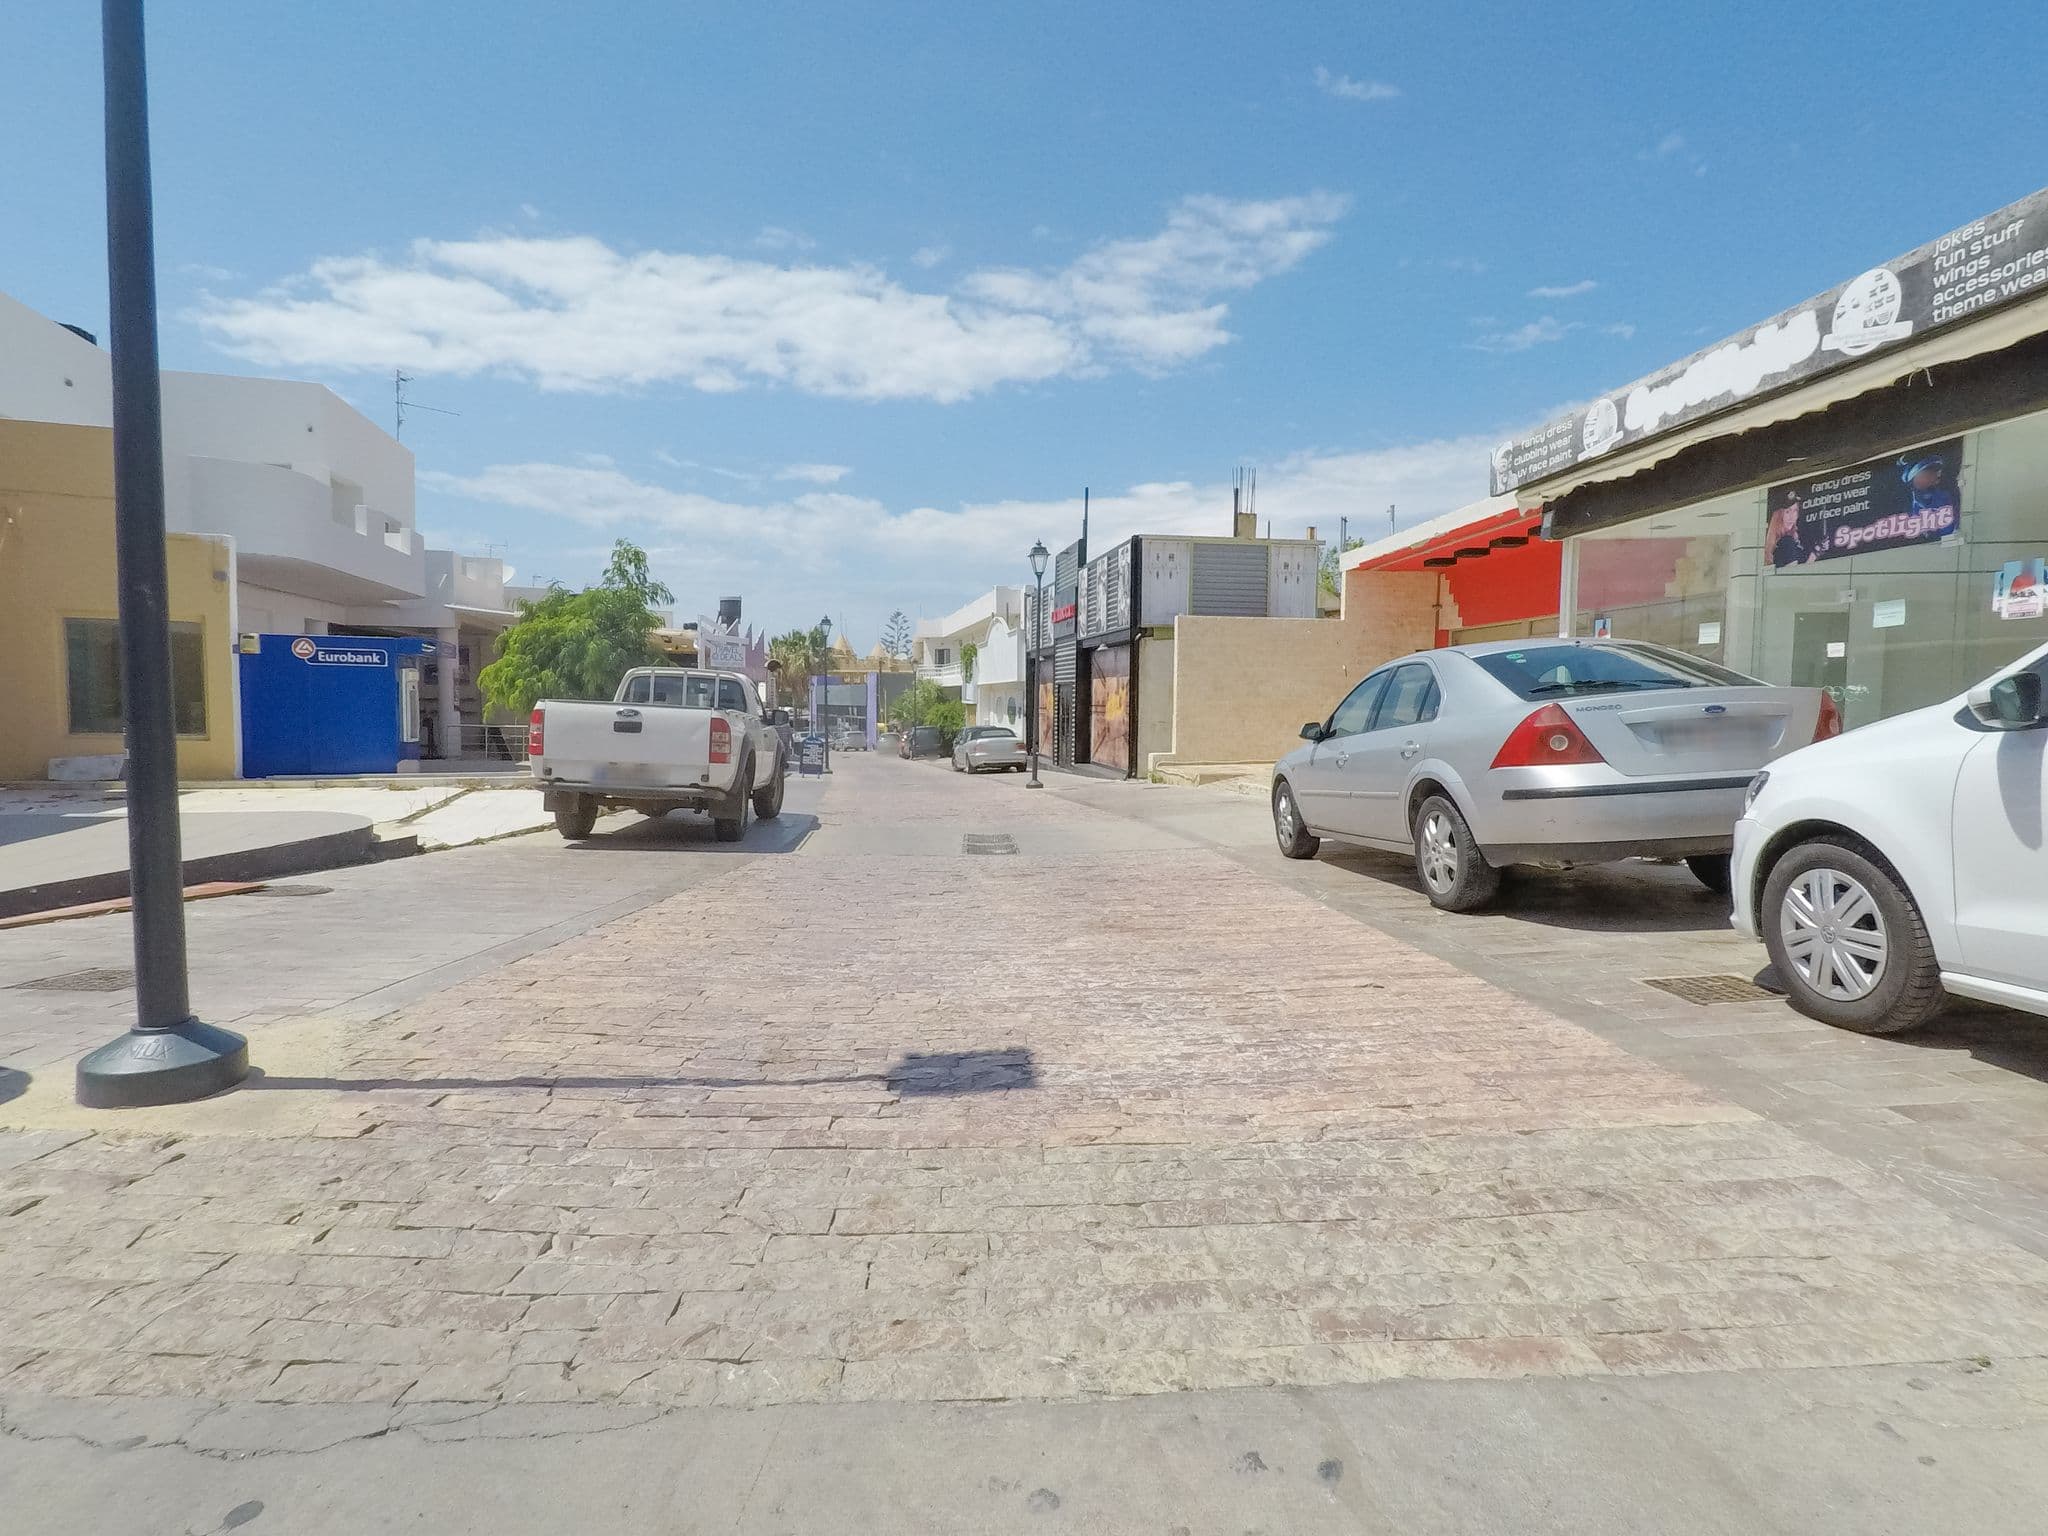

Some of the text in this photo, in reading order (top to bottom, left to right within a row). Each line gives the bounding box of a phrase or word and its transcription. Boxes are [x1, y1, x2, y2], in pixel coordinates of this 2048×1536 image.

[1932, 221, 1985, 258] jokes
[1934, 220, 2024, 271] fun stuff
[1933, 255, 1990, 288] wings
[1932, 265, 2048, 323] theme wea
[1514, 446, 1548, 466] clubbing
[1549, 434, 1573, 452] wear
[1521, 420, 1573, 450] fancy dress
[1518, 449, 1573, 478] uv face paint
[1811, 470, 1872, 494] fancy dress
[1802, 485, 1871, 510] clubbing wear
[1805, 500, 1870, 523] uv face paint
[1834, 505, 1954, 549] Spotlight
[318, 651, 381, 664] Eurobank
[1576, 704, 1623, 713] MONDEO
